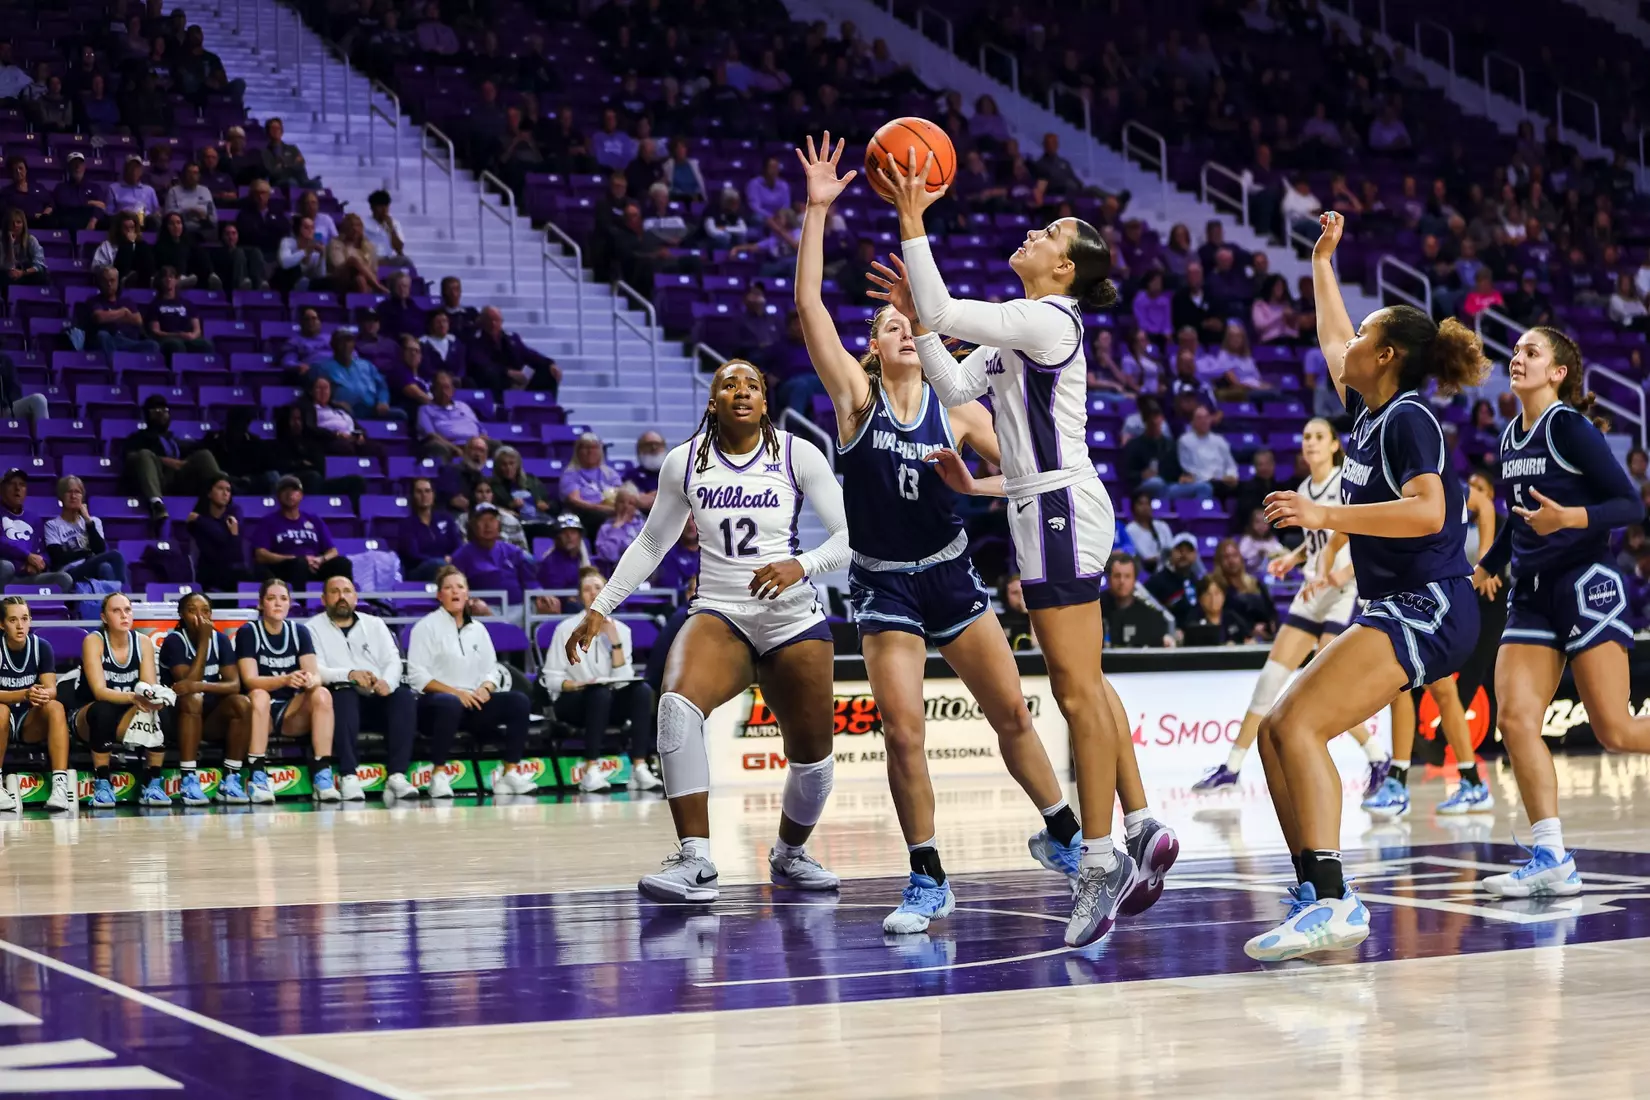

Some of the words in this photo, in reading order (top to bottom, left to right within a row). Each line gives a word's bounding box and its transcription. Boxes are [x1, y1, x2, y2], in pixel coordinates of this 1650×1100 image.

[1501, 457, 1547, 479] ASHBURN
[898, 463, 919, 501] 13
[696, 485, 781, 510] Wildcats
[719, 516, 760, 559] 12
[745, 725, 780, 738] AUTO
[1155, 714, 1243, 746] SMOO
[742, 752, 788, 770] GM
[835, 753, 856, 763] WE
[861, 751, 886, 762] ARE
[927, 748, 994, 760] ESSIONAL
[411, 764, 460, 788] LIBAN
